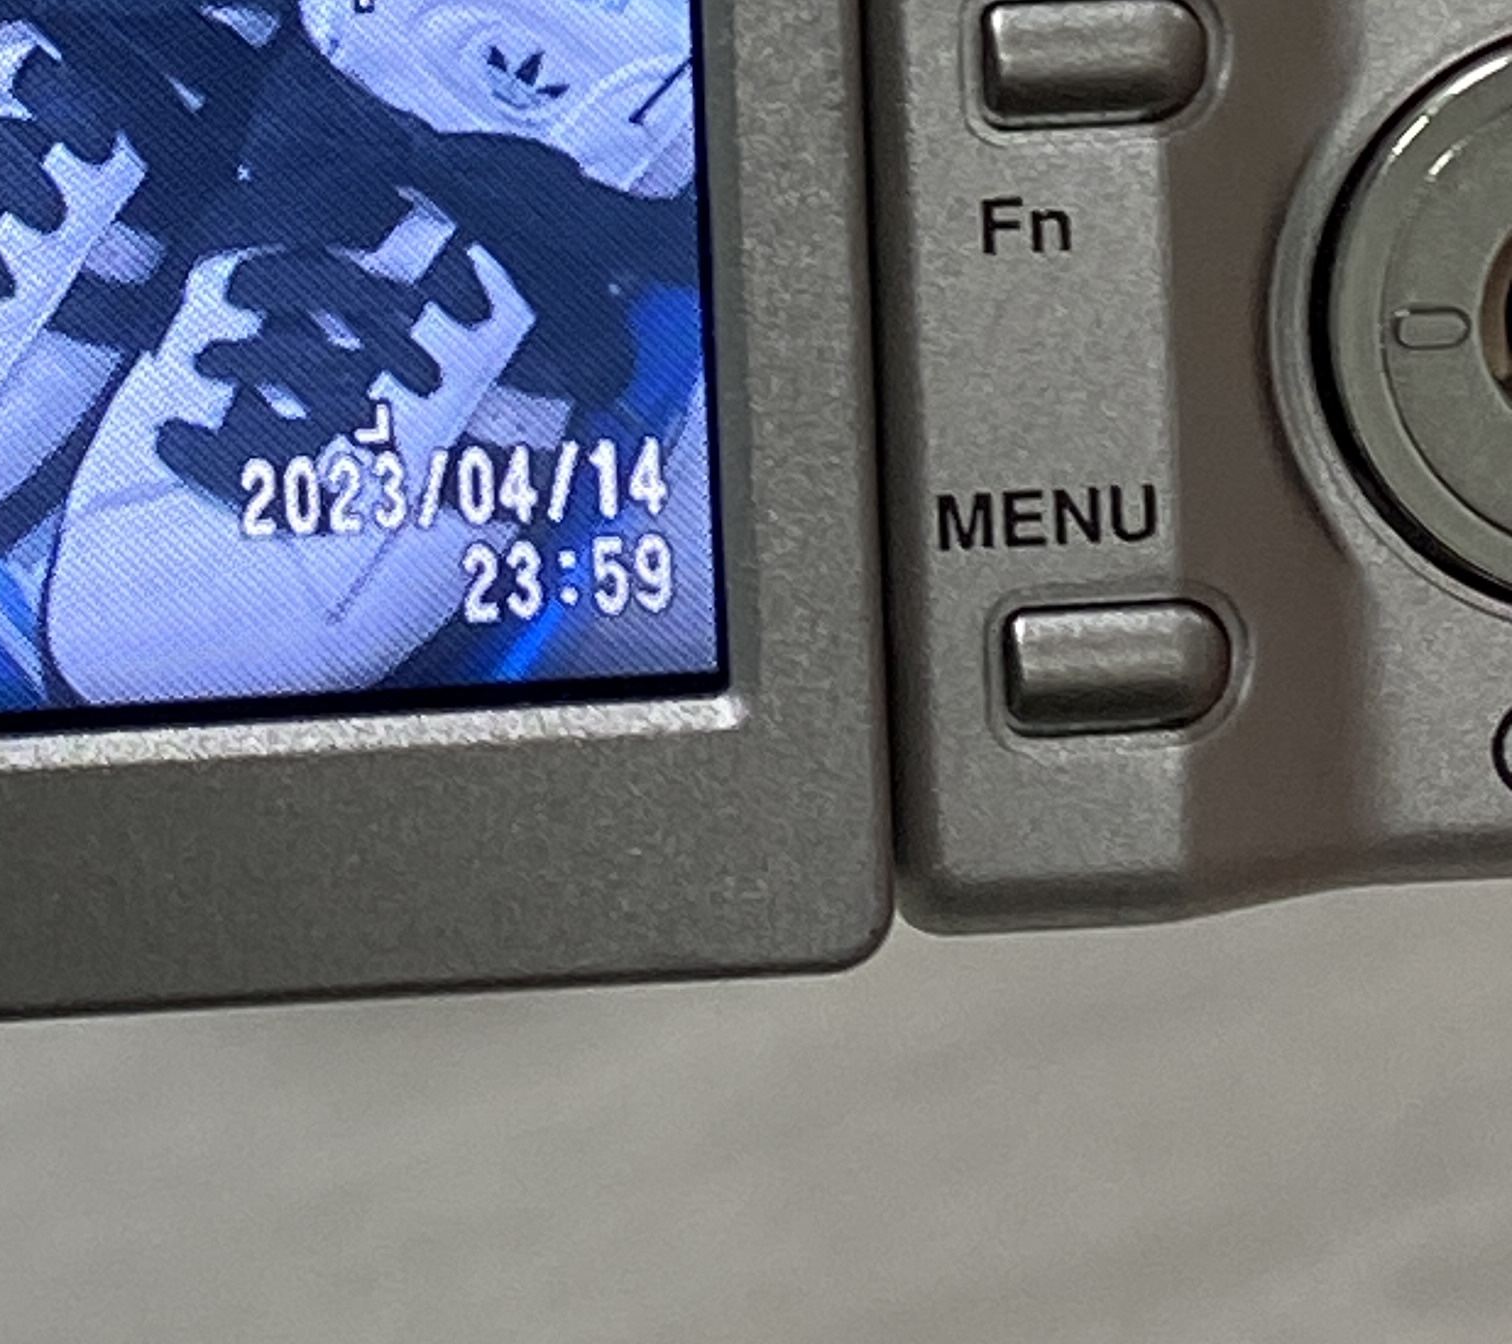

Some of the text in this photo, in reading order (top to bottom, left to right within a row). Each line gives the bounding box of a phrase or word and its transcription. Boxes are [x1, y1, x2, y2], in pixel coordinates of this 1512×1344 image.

[980, 197, 1073, 255] Fn
[241, 436, 668, 536] 2023/04/14
[937, 485, 1159, 551] MENU
[463, 534, 672, 624] 23:59
